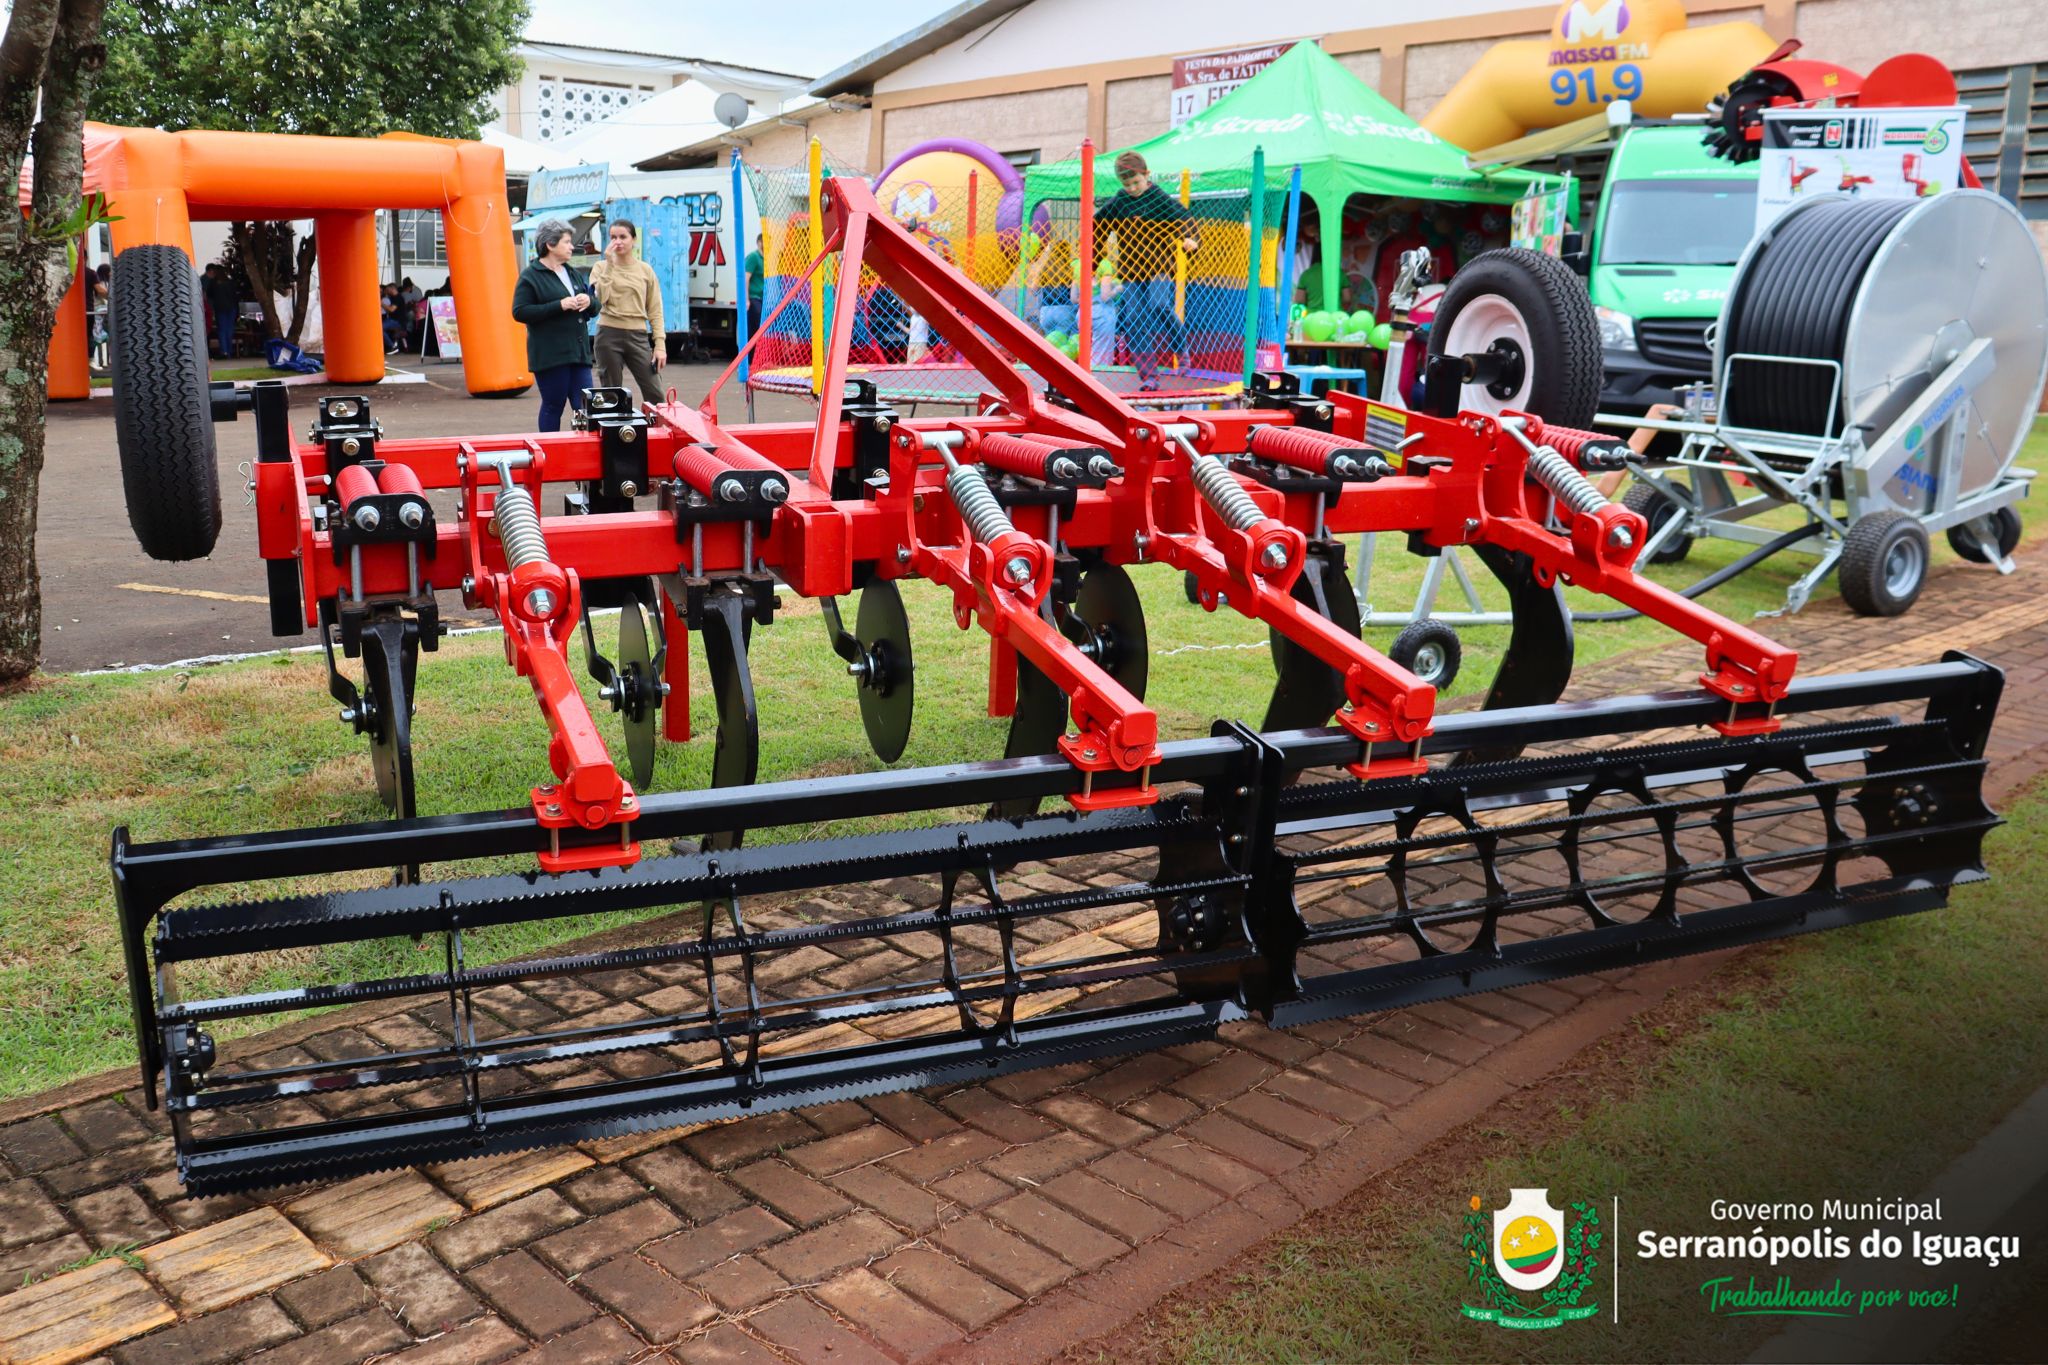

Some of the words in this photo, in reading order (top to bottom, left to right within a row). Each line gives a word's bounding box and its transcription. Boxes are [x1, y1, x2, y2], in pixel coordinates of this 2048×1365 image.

[1618, 42, 1649, 60] FM
[1184, 73, 1196, 85] N.
[1197, 71, 1217, 82] Sra.
[1219, 68, 1231, 80] de
[1550, 63, 1643, 106] 91.9
[1176, 94, 1195, 115] 17
[550, 170, 603, 198] CHURROS
